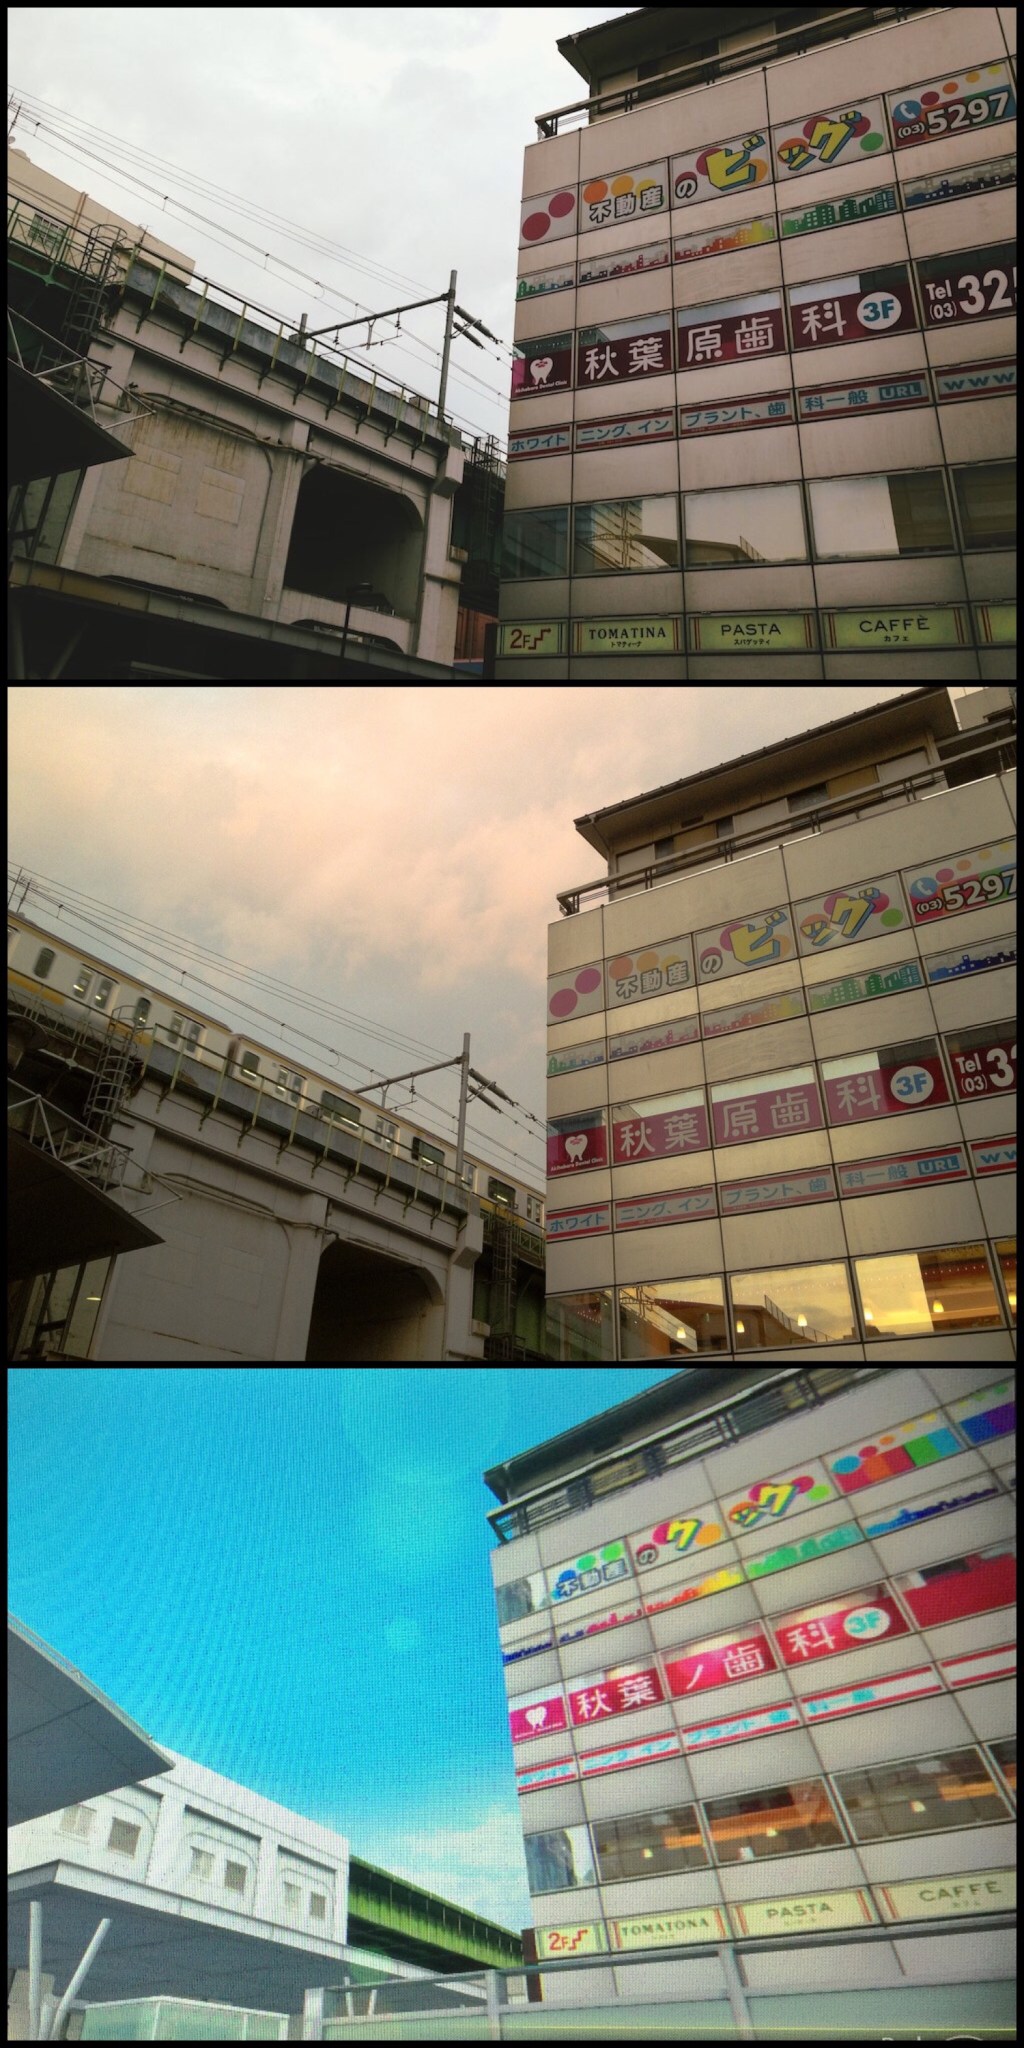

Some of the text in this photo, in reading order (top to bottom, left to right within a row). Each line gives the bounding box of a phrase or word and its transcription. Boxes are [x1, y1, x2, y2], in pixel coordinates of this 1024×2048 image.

[925, 279, 952, 300] Tel
[929, 266, 1017, 320] (03) 32
[861, 299, 897, 323] 3F
[584, 301, 846, 381] 秋葉原歯科
[882, 382, 922, 399] URL
[588, 626, 667, 641] TOMATINA
[720, 623, 782, 637] PASTA
[858, 614, 931, 633] CAFFÈ
[510, 628, 531, 650] 2F
[883, 635, 909, 643] カフェ
[955, 1052, 982, 1074] Tel
[895, 1073, 927, 1096] 3F
[961, 1074, 988, 1094] (03)
[620, 1075, 881, 1157] 秋葉原歯科
[920, 1157, 961, 1174] URL
[847, 1608, 881, 1635] 3F
[765, 1902, 834, 1919] PASTA
[621, 1918, 710, 1937] TOMATONA
[547, 1932, 569, 1951] 2F
